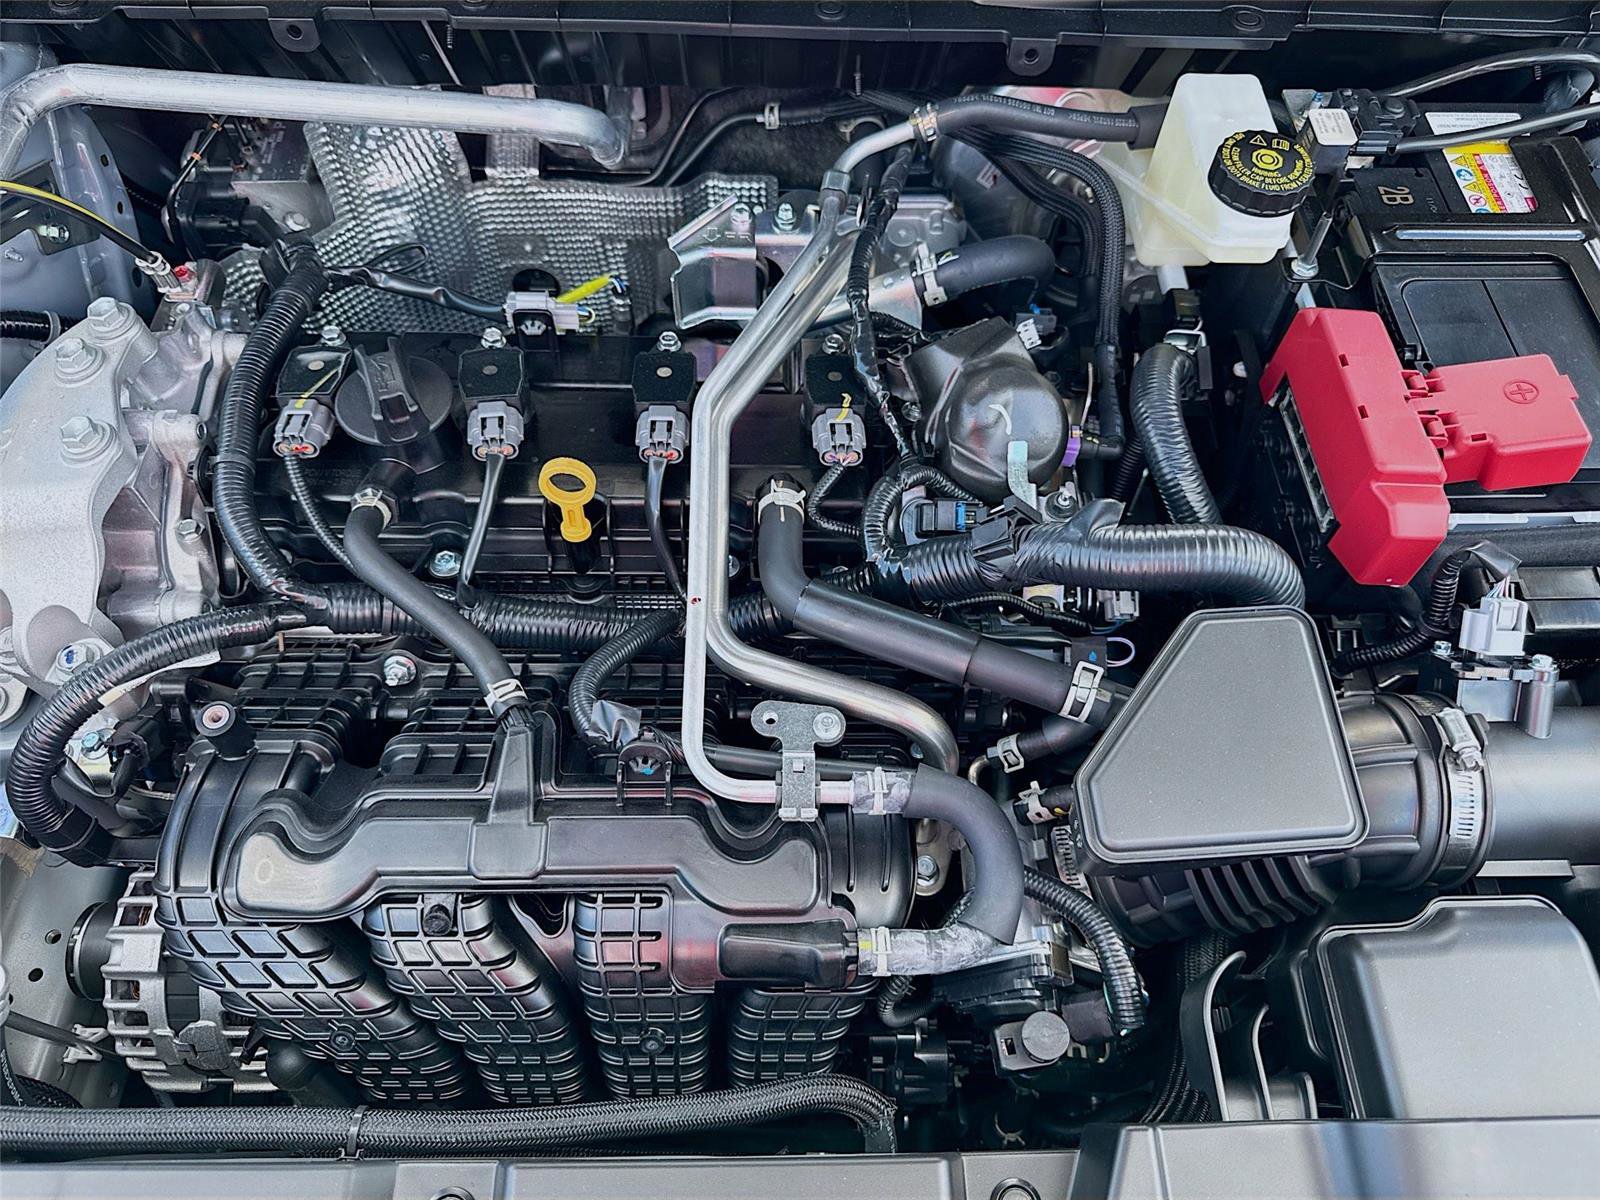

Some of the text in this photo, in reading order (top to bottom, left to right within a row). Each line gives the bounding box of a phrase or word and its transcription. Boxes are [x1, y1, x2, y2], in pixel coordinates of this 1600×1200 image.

[1234, 161, 1252, 176] FILLER
[1251, 173, 1264, 181] CAP
[1288, 160, 1304, 180] REMOVING
[1240, 175, 1260, 188] BRAKE
[1261, 183, 1281, 191] FLUID
[1281, 182, 1298, 191] FROM
[1299, 168, 1312, 183] SEALED
[1252, 167, 1282, 177] WARNING
[1377, 185, 1414, 205] 2B
